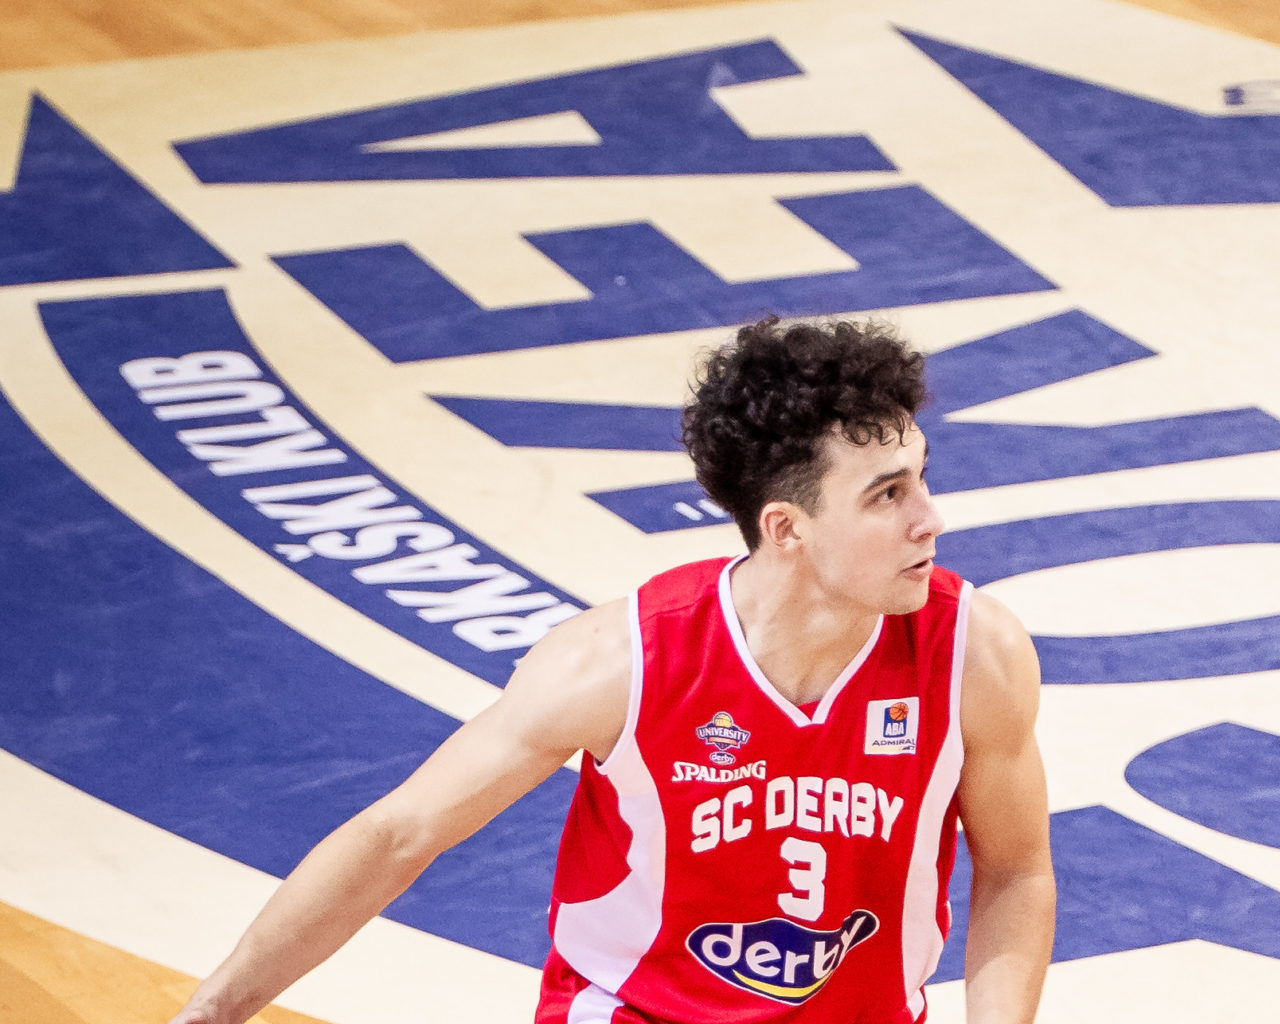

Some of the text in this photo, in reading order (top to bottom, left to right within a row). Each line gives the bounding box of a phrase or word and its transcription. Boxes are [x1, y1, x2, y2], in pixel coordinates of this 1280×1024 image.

[119, 349, 583, 668] RKAŠKI KLUB
[698, 727, 748, 742] UNIVERSITY
[872, 737, 916, 747] ADMIRAL
[885, 721, 904, 737] ABA
[672, 760, 766, 783] SPALDING
[691, 776, 904, 853] SC DERBY
[777, 836, 828, 922] 3
[701, 914, 868, 985] derby
